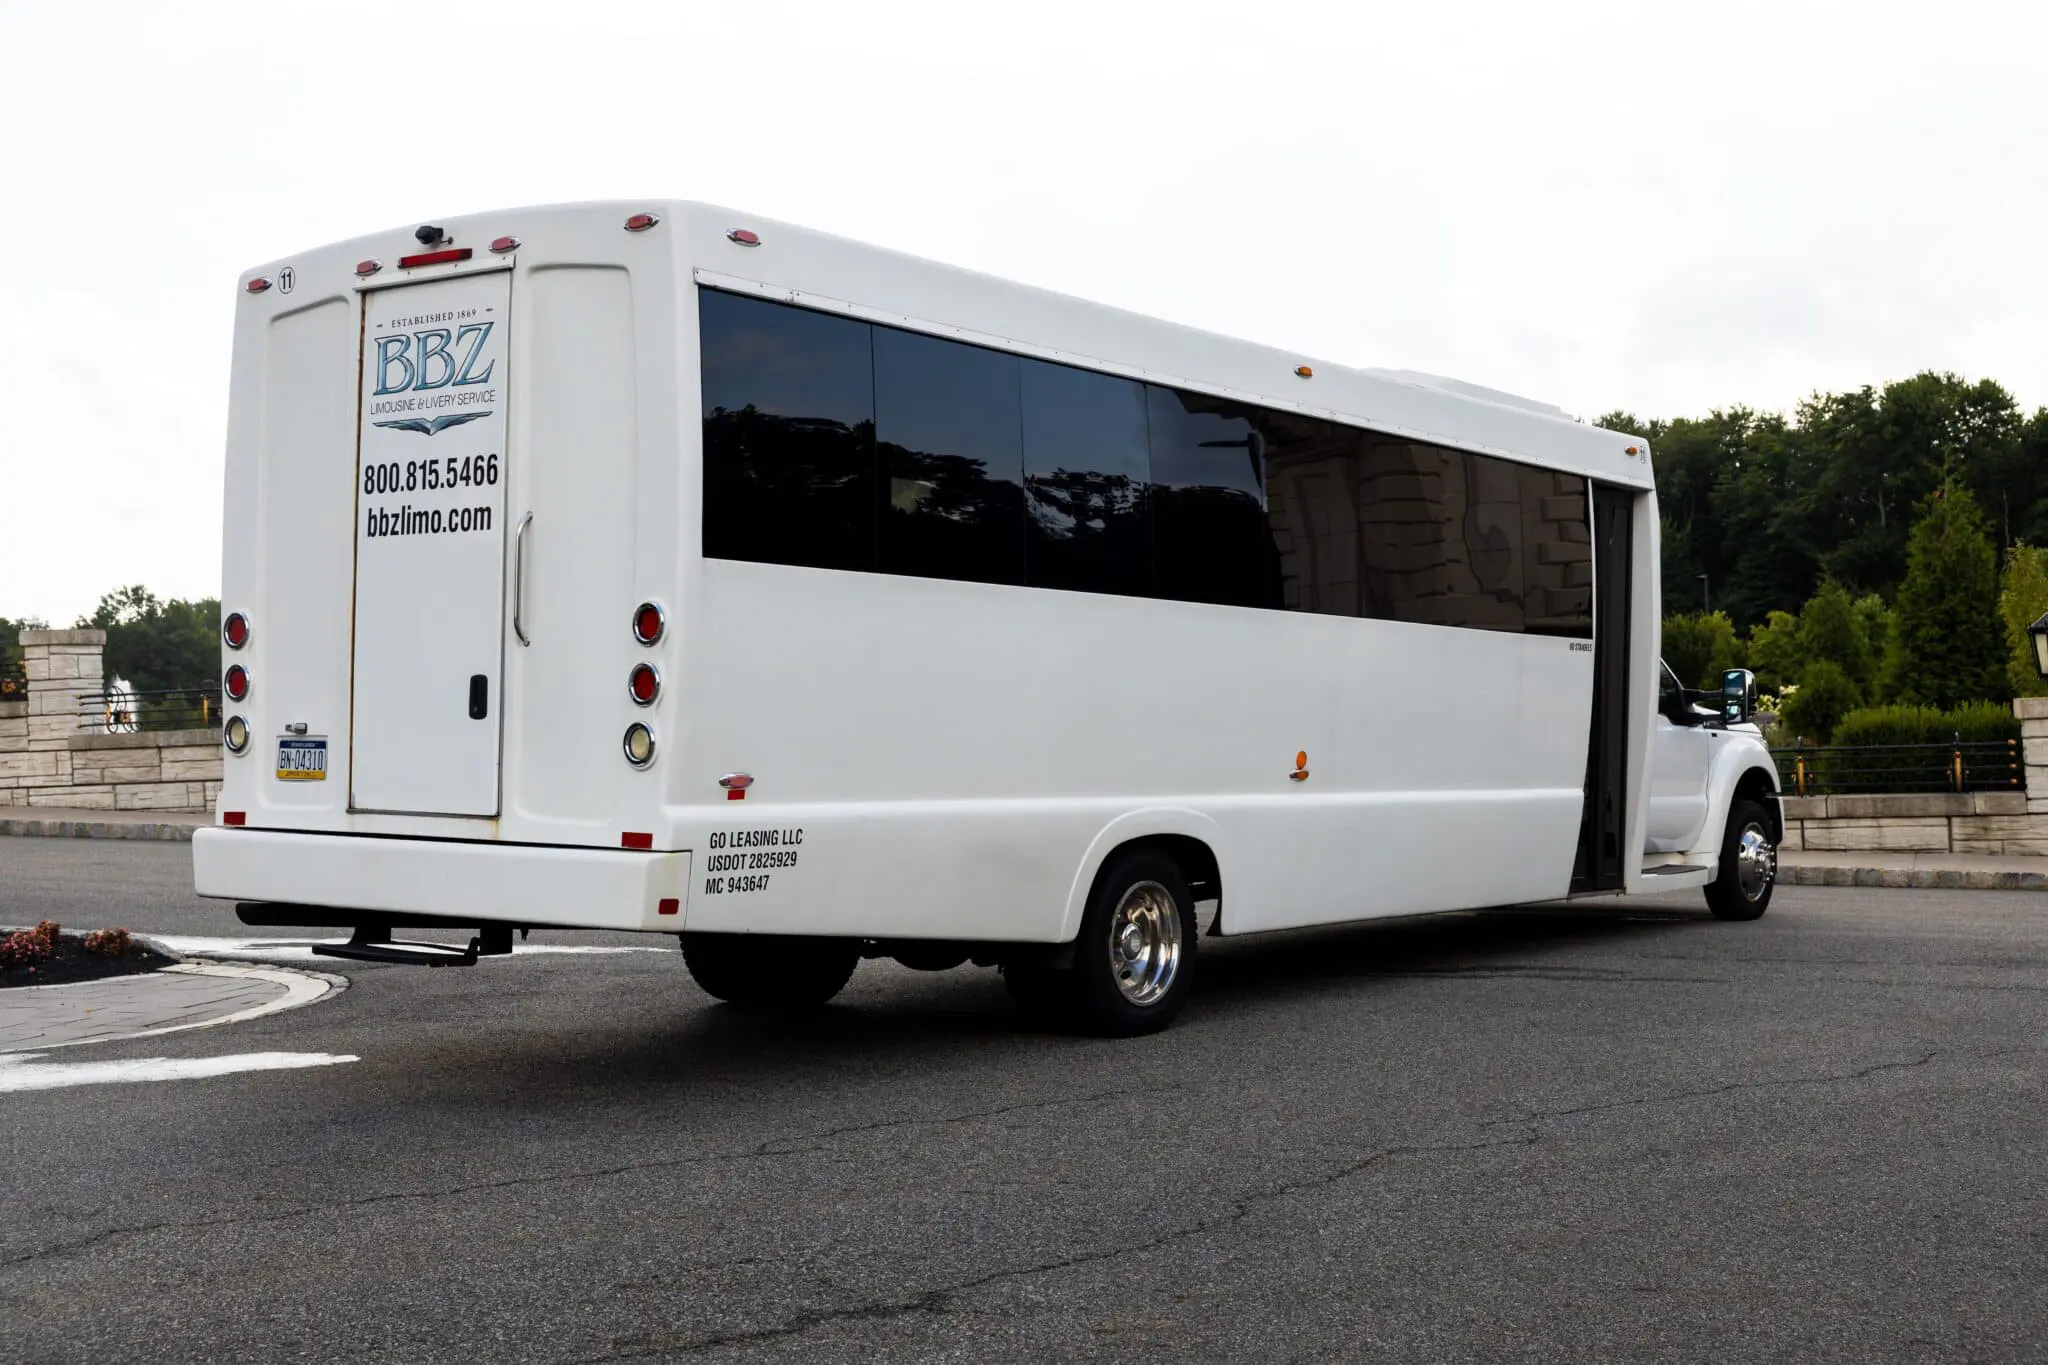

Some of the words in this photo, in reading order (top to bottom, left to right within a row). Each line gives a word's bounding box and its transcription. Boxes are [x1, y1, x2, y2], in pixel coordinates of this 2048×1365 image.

[281, 271, 291, 290] 11
[391, 312, 454, 328] ESTABLISHED
[457, 308, 477, 320] 1869
[373, 321, 495, 396] BBZ
[370, 398, 416, 415] LIMOUSINE
[417, 399, 426, 410] &
[425, 393, 457, 409] LIVERY
[457, 389, 496, 406] SERVICE
[364, 453, 498, 495] 800.815.5466
[367, 504, 492, 538] bbzlimo.com
[280, 750, 324, 770] BN-04310
[710, 832, 726, 849] GO
[730, 830, 779, 848] LEASING
[782, 828, 803, 845] LLC
[707, 854, 747, 872] USDOT
[749, 851, 797, 870] 2825929
[705, 877, 724, 895] MC
[727, 875, 770, 893] 943647
